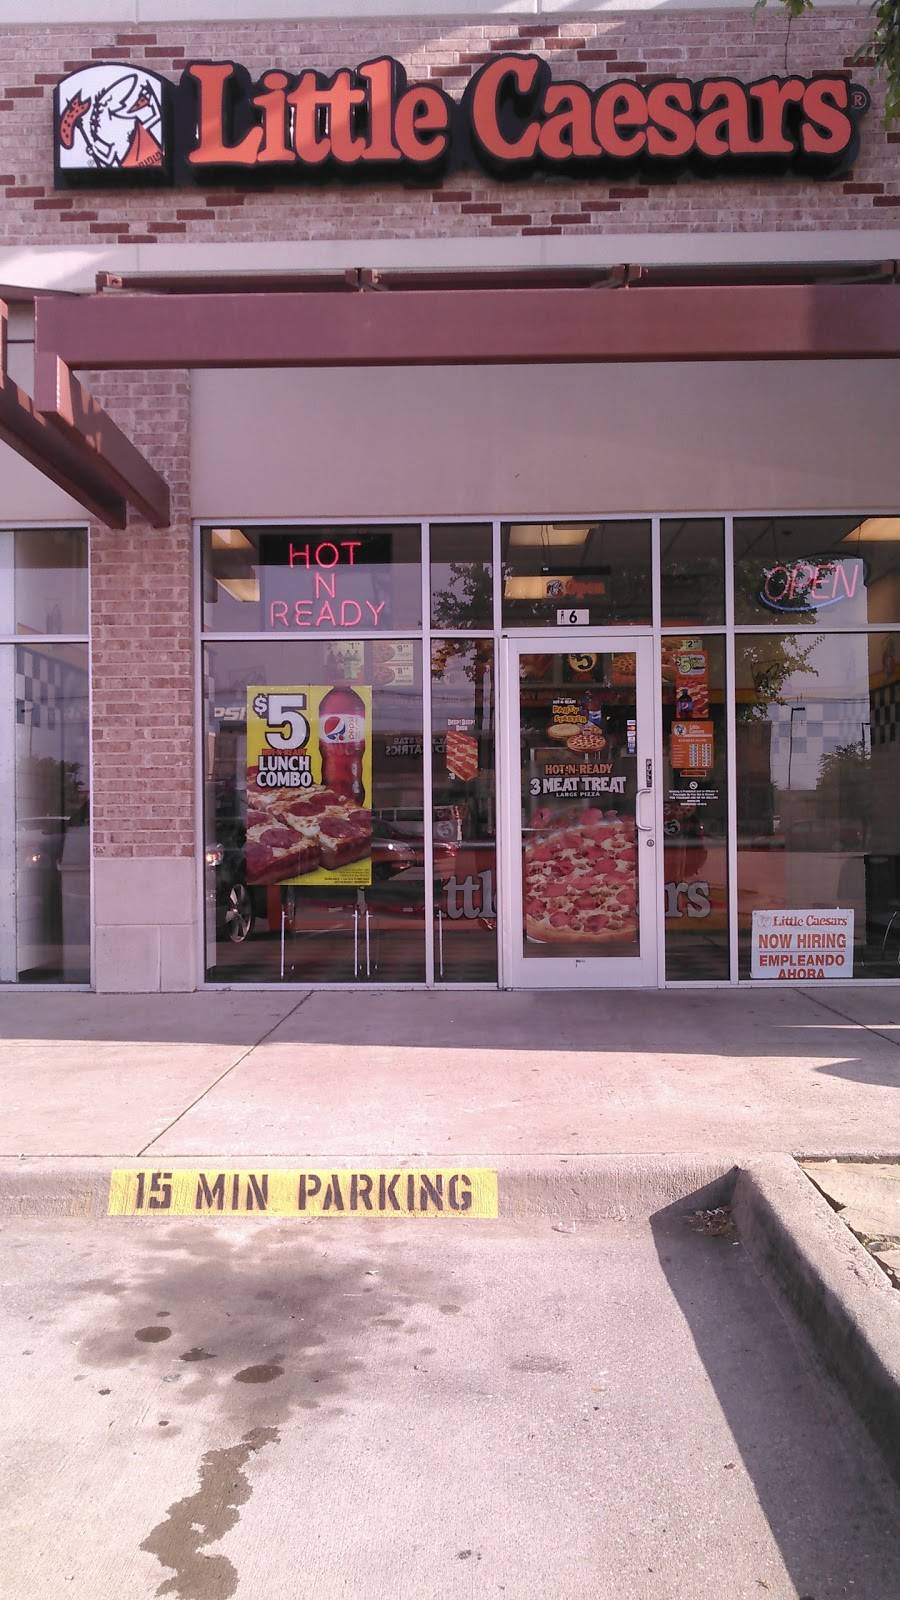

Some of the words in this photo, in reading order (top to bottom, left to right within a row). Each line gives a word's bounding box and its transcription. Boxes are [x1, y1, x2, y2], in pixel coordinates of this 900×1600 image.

[186, 58, 449, 166] Little
[470, 55, 853, 161] Caesars
[288, 541, 362, 568] HOT
[315, 572, 336, 599] N
[763, 563, 859, 601] OPEN
[270, 600, 386, 627] READY
[253, 693, 309, 750] $5
[258, 755, 310, 771] LUNCH
[256, 771, 313, 787] COMBO
[530, 778, 541, 795] 3
[542, 777, 580, 794] MEAT
[581, 776, 627, 793] TREAT
[442, 870, 496, 919] ttl
[773, 915, 804, 926] Little
[806, 914, 848, 926] Caesars
[758, 934, 792, 948] NOW
[797, 933, 846, 948] HIRING
[759, 954, 845, 967] EMPLEANDO
[778, 968, 825, 978] AHORA
[136, 1172, 173, 1209] 15
[195, 1172, 269, 1211] MIN
[297, 1173, 473, 1211] PARKING
